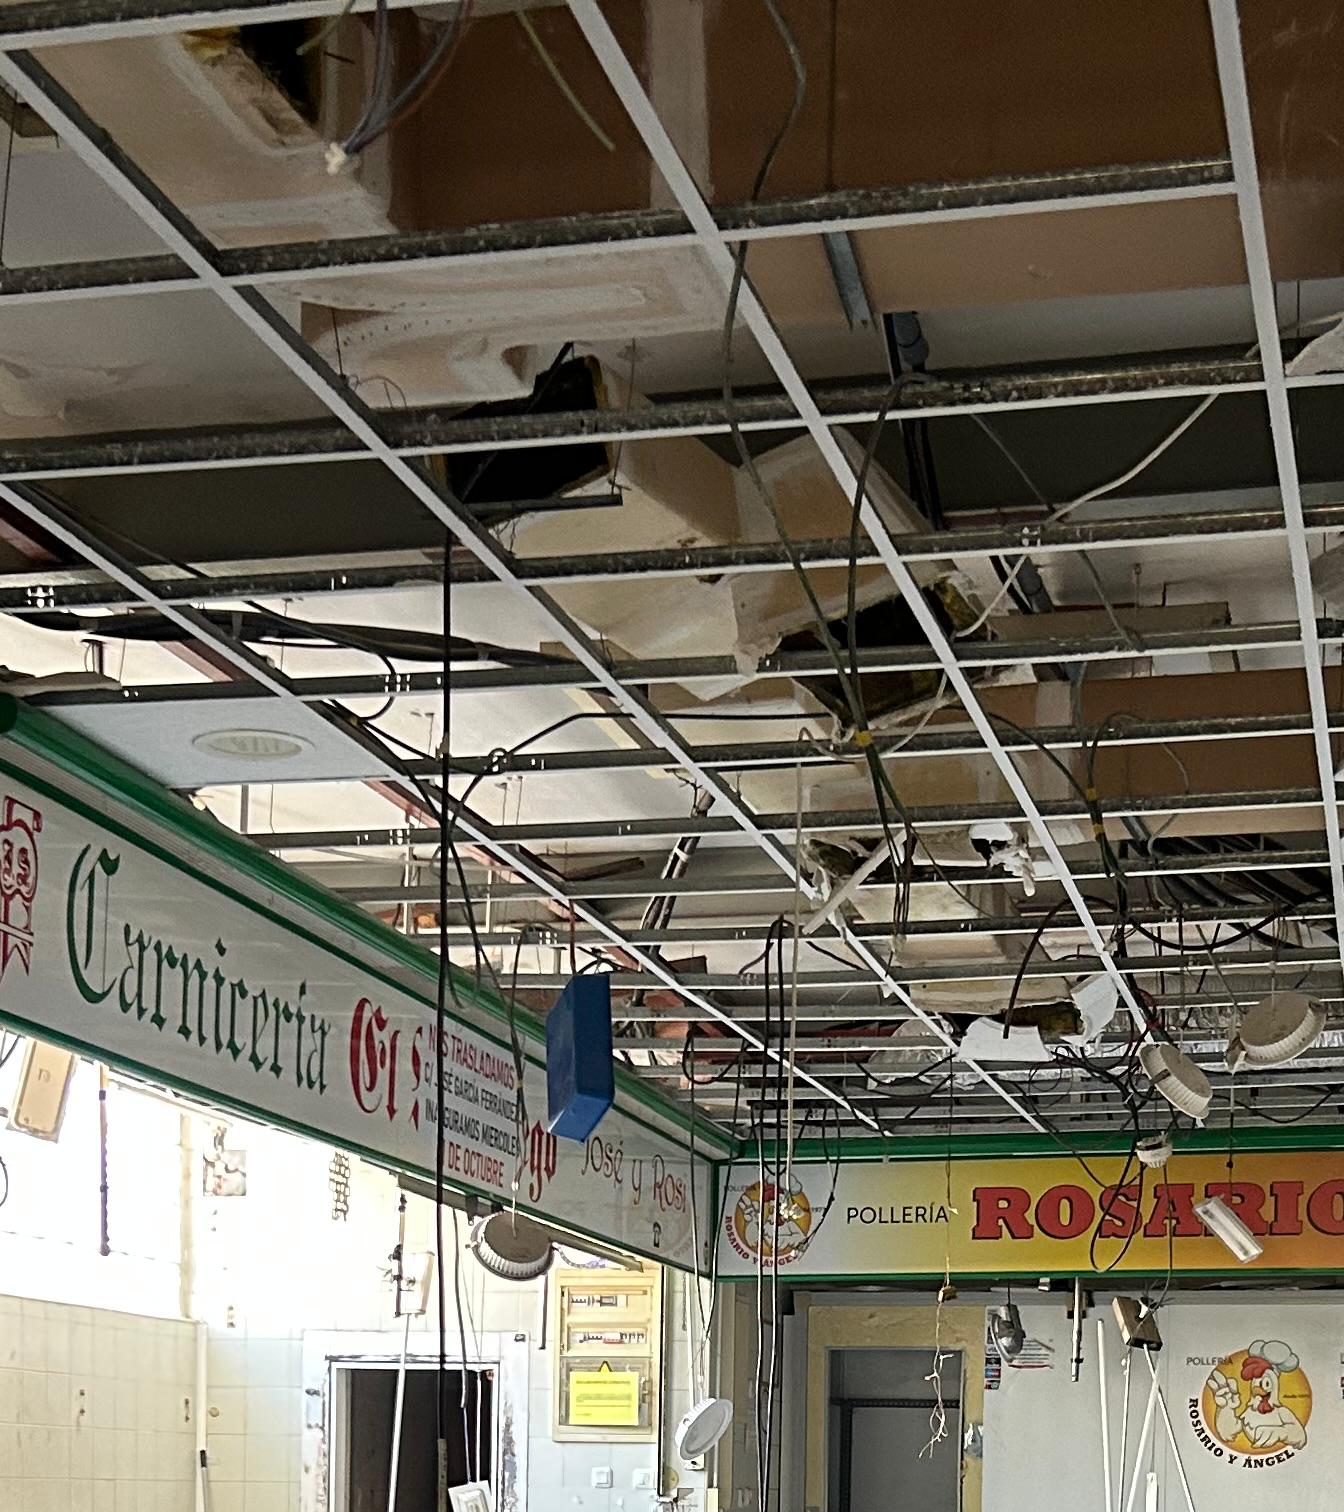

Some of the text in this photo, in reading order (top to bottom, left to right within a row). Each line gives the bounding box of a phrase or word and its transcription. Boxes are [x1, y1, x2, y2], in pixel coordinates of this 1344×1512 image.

[428, 1023, 449, 1057] NS
[451, 1034, 515, 1091] TRASLADAMOS
[425, 1098, 480, 1142] INAGURAMOS
[481, 1122, 518, 1157] MIERCOLE
[448, 1141, 462, 1172] DE
[463, 1148, 505, 1188] OCTUBRE
[846, 1201, 950, 1225] POLLERÍA
[1188, 1398, 1224, 1457] ROSARIO
[1227, 1453, 1238, 1465] Y
